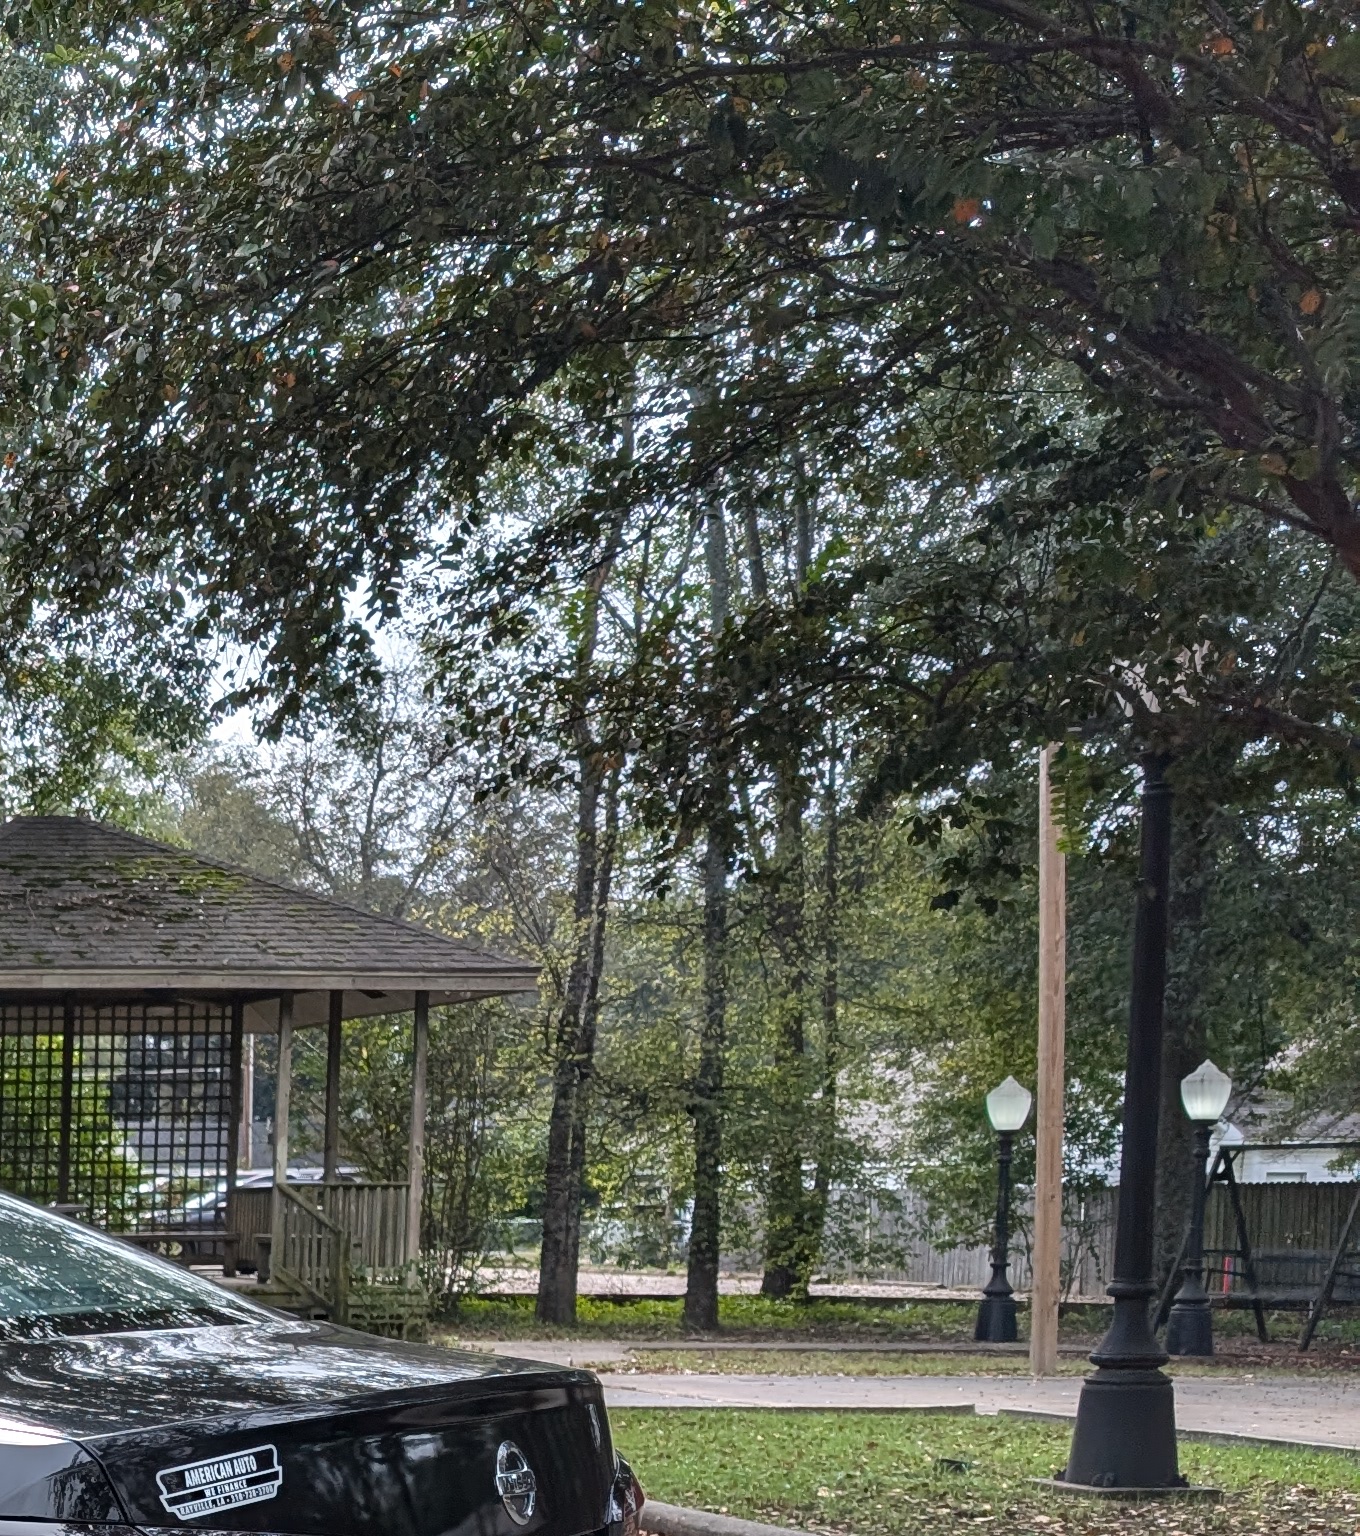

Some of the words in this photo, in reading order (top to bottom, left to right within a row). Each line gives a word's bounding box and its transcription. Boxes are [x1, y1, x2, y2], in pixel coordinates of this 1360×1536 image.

[184, 1461, 234, 1488] AMERICAN
[233, 1455, 257, 1476] AUTO
[217, 1480, 247, 1495] FINANCE
